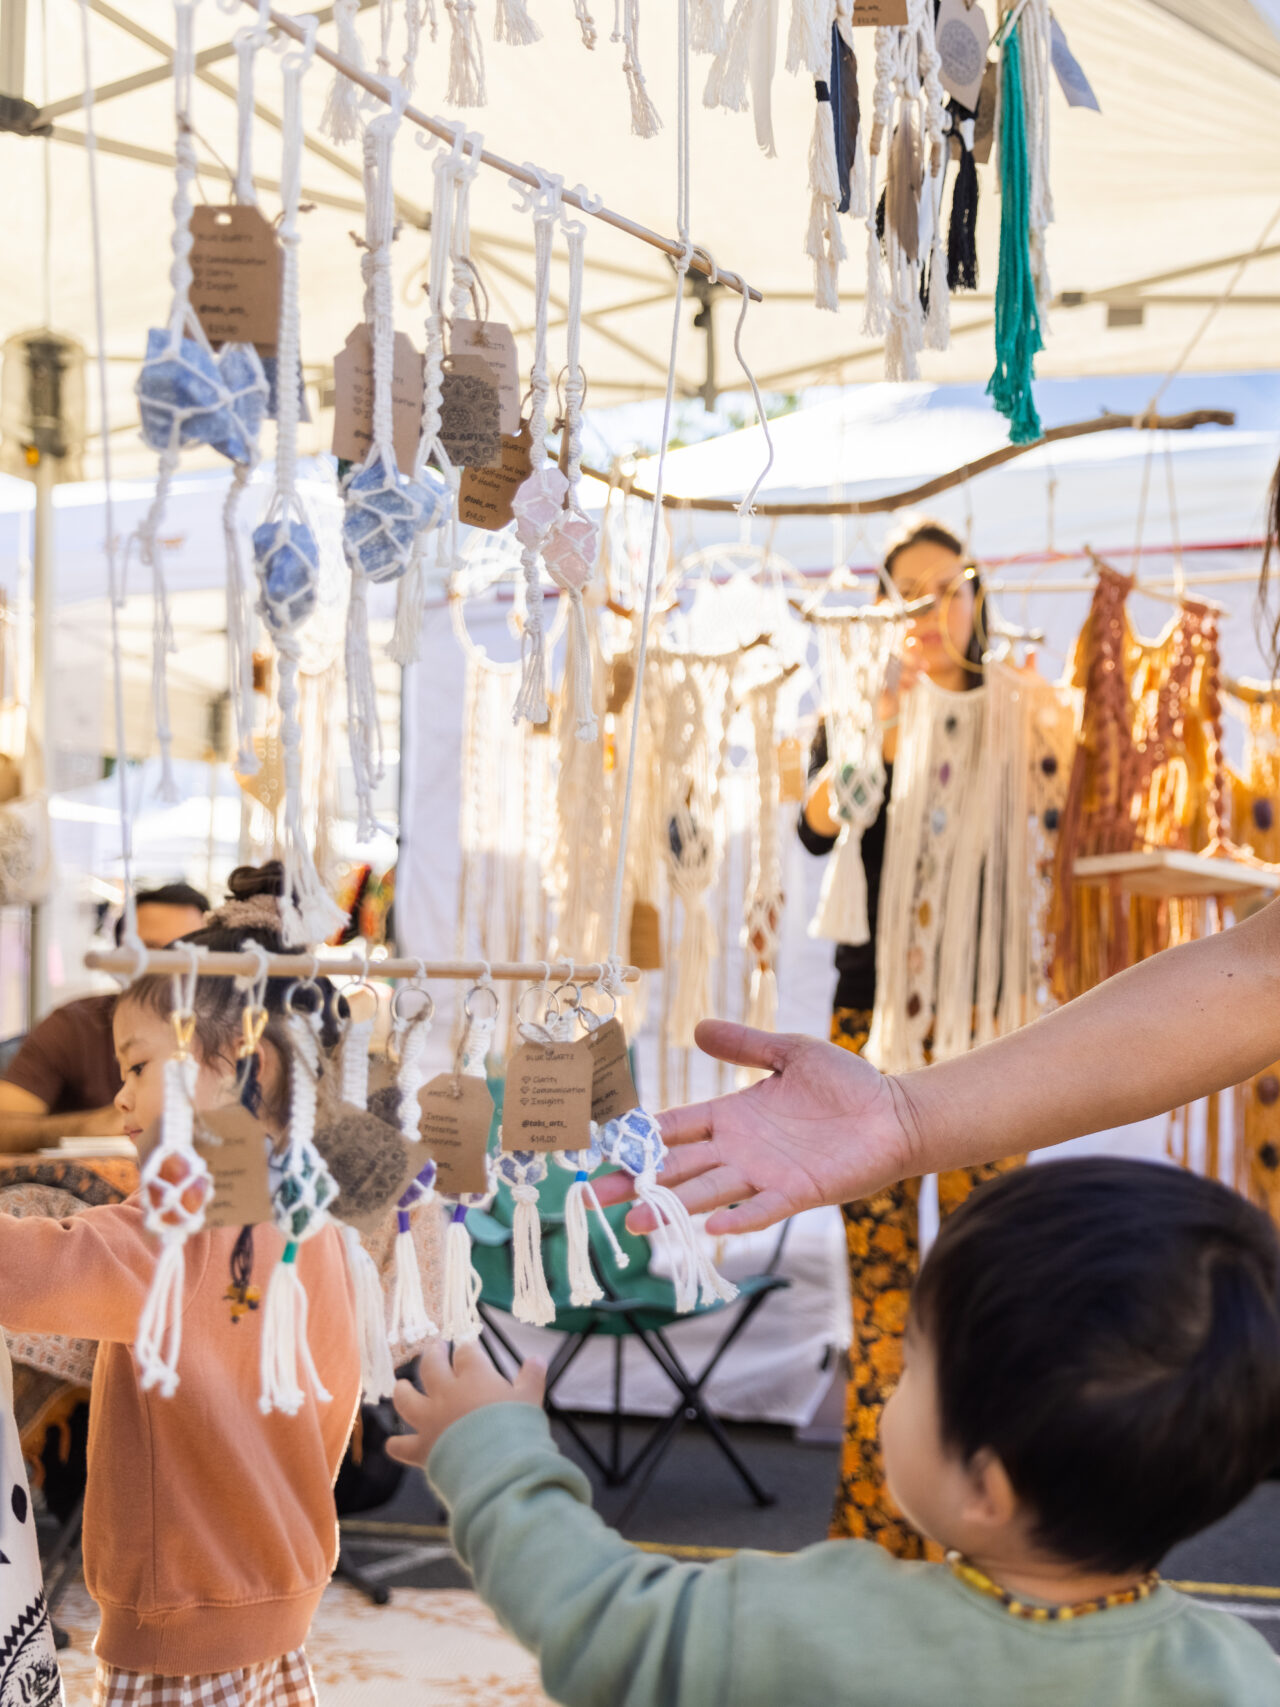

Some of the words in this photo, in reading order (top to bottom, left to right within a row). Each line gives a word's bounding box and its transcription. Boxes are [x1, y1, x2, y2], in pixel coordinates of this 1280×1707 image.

[532, 1076, 558, 1085] Clarity
[531, 1086, 586, 1095] Communication
[530, 1097, 565, 1107] Insights
